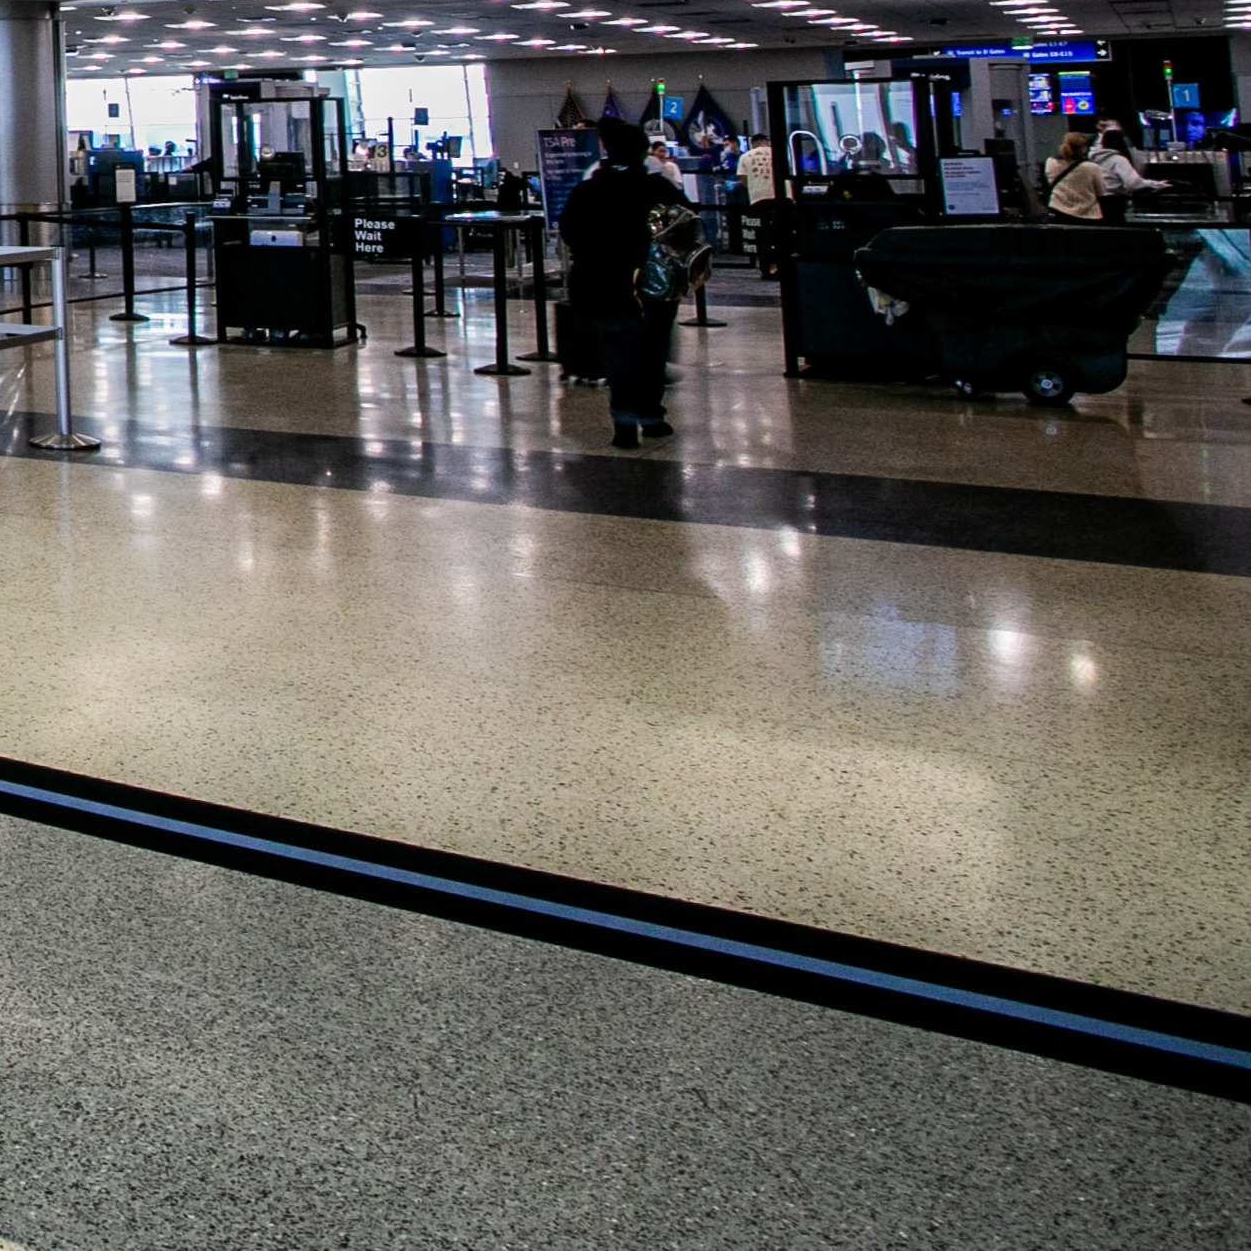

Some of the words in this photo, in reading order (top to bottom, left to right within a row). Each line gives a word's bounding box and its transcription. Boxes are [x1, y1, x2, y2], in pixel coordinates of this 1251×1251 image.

[1182, 89, 1190, 102] 1
[670, 101, 678, 114] 2
[543, 137, 560, 148] TSA
[560, 137, 576, 148] Pre
[377, 144, 388, 158] 3
[354, 218, 396, 230] Please
[354, 230, 382, 241] Wait
[355, 241, 384, 253] Here
